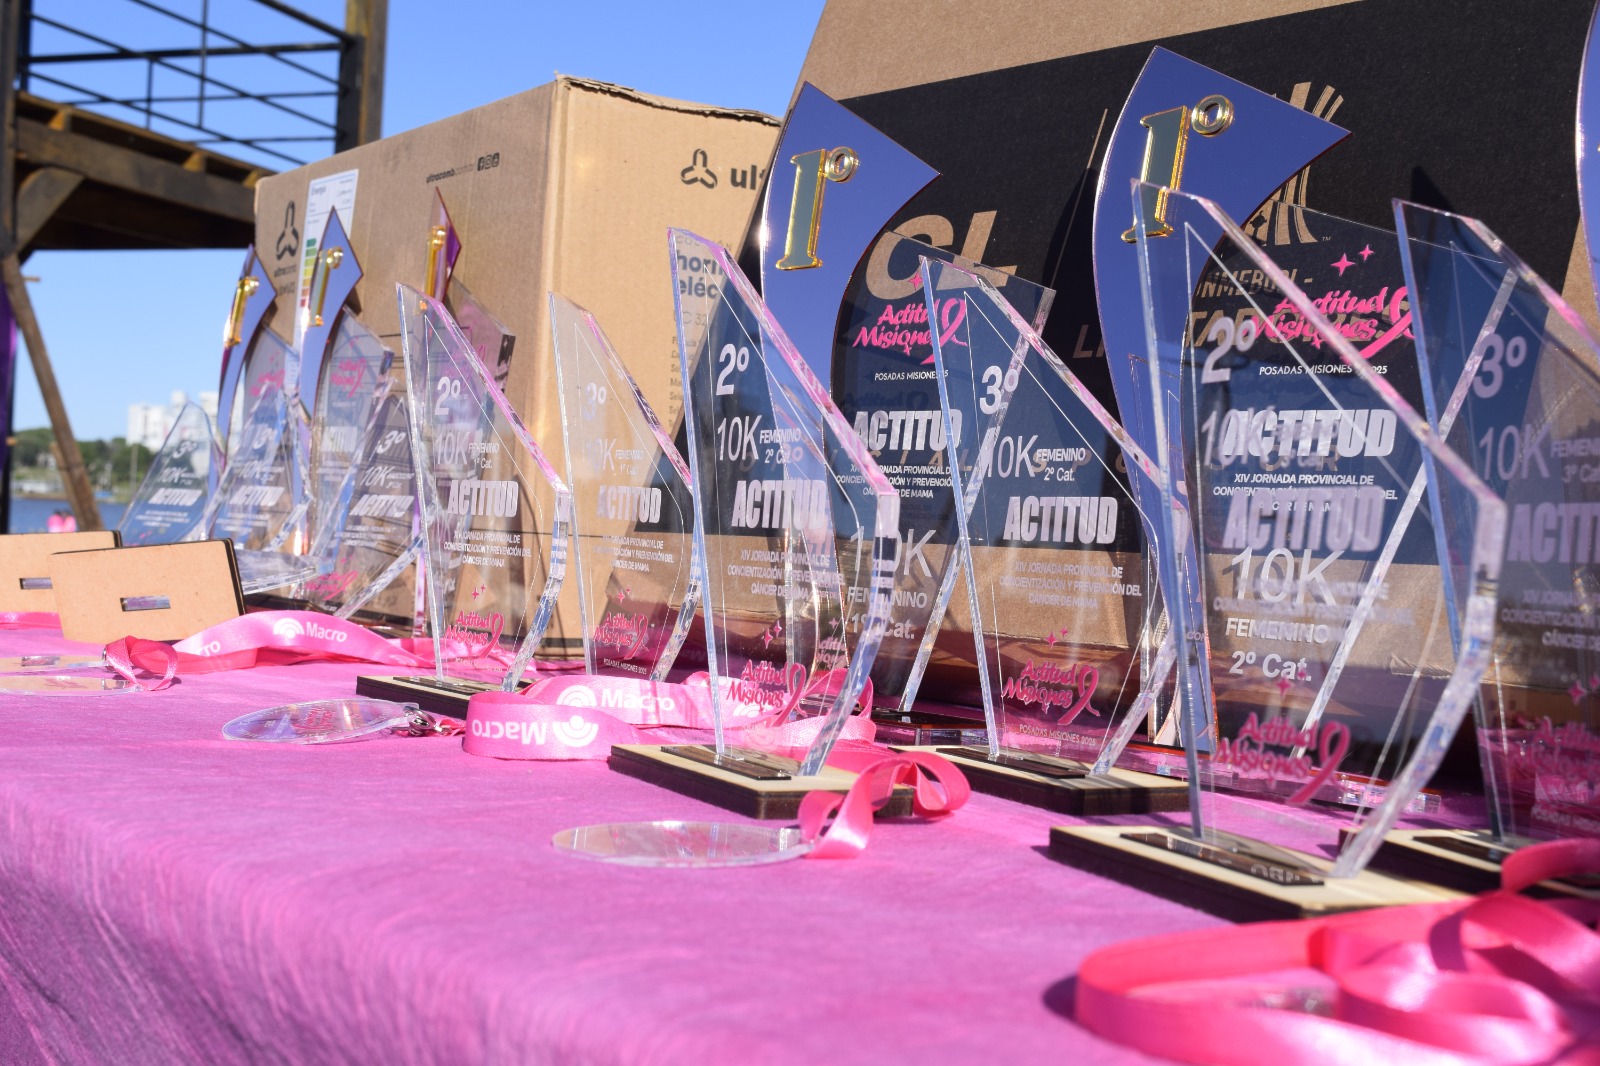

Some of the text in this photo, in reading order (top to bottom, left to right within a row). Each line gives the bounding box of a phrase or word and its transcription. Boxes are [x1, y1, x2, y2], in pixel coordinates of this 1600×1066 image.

[1201, 317, 1257, 384] 2º
[1472, 333, 1527, 398] 3º
[716, 343, 749, 396] 2º
[874, 372, 905, 381] POSADAS
[1259, 366, 1303, 376] POSADAS
[434, 376, 461, 416] 2º
[979, 365, 1019, 415] 3º
[717, 415, 801, 462] 10K FEMENINO
[1223, 409, 1397, 458] ACTITUD
[1036, 447, 1086, 462] FEMENINO
[1479, 423, 1549, 481] 10K
[1056, 467, 1075, 482] Cat.
[1251, 474, 1296, 484] JORNADA
[1298, 474, 1358, 485] PROVINCIAL
[1359, 475, 1374, 485] DE
[447, 480, 519, 518] ACTITUD
[596, 485, 662, 525] ACTITUD
[731, 479, 828, 531] ACTITUD
[911, 489, 934, 499] MAMA
[1003, 496, 1118, 545] ACTITUD
[1221, 485, 1386, 553] ACTITUD
[1027, 562, 1061, 575] JORNADA
[1063, 564, 1111, 578] PROVINCIAL
[1111, 566, 1123, 578] DE
[1231, 547, 1345, 607] 10K
[1073, 581, 1125, 595] PREVENCIÓN
[1126, 584, 1142, 597] DEL
[305, 621, 347, 643] Macro
[1226, 617, 1329, 643] FEMENINO
[741, 660, 789, 686] Actitud
[1020, 659, 1078, 686] Actitud
[1229, 650, 1312, 682] 2º Cat.
[601, 688, 675, 712] Macro
[1001, 677, 1073, 712] Misiones
[471, 718, 547, 745] Macro
[1020, 724, 1048, 737] POSADAS
[1049, 730, 1080, 743] MISIONES
